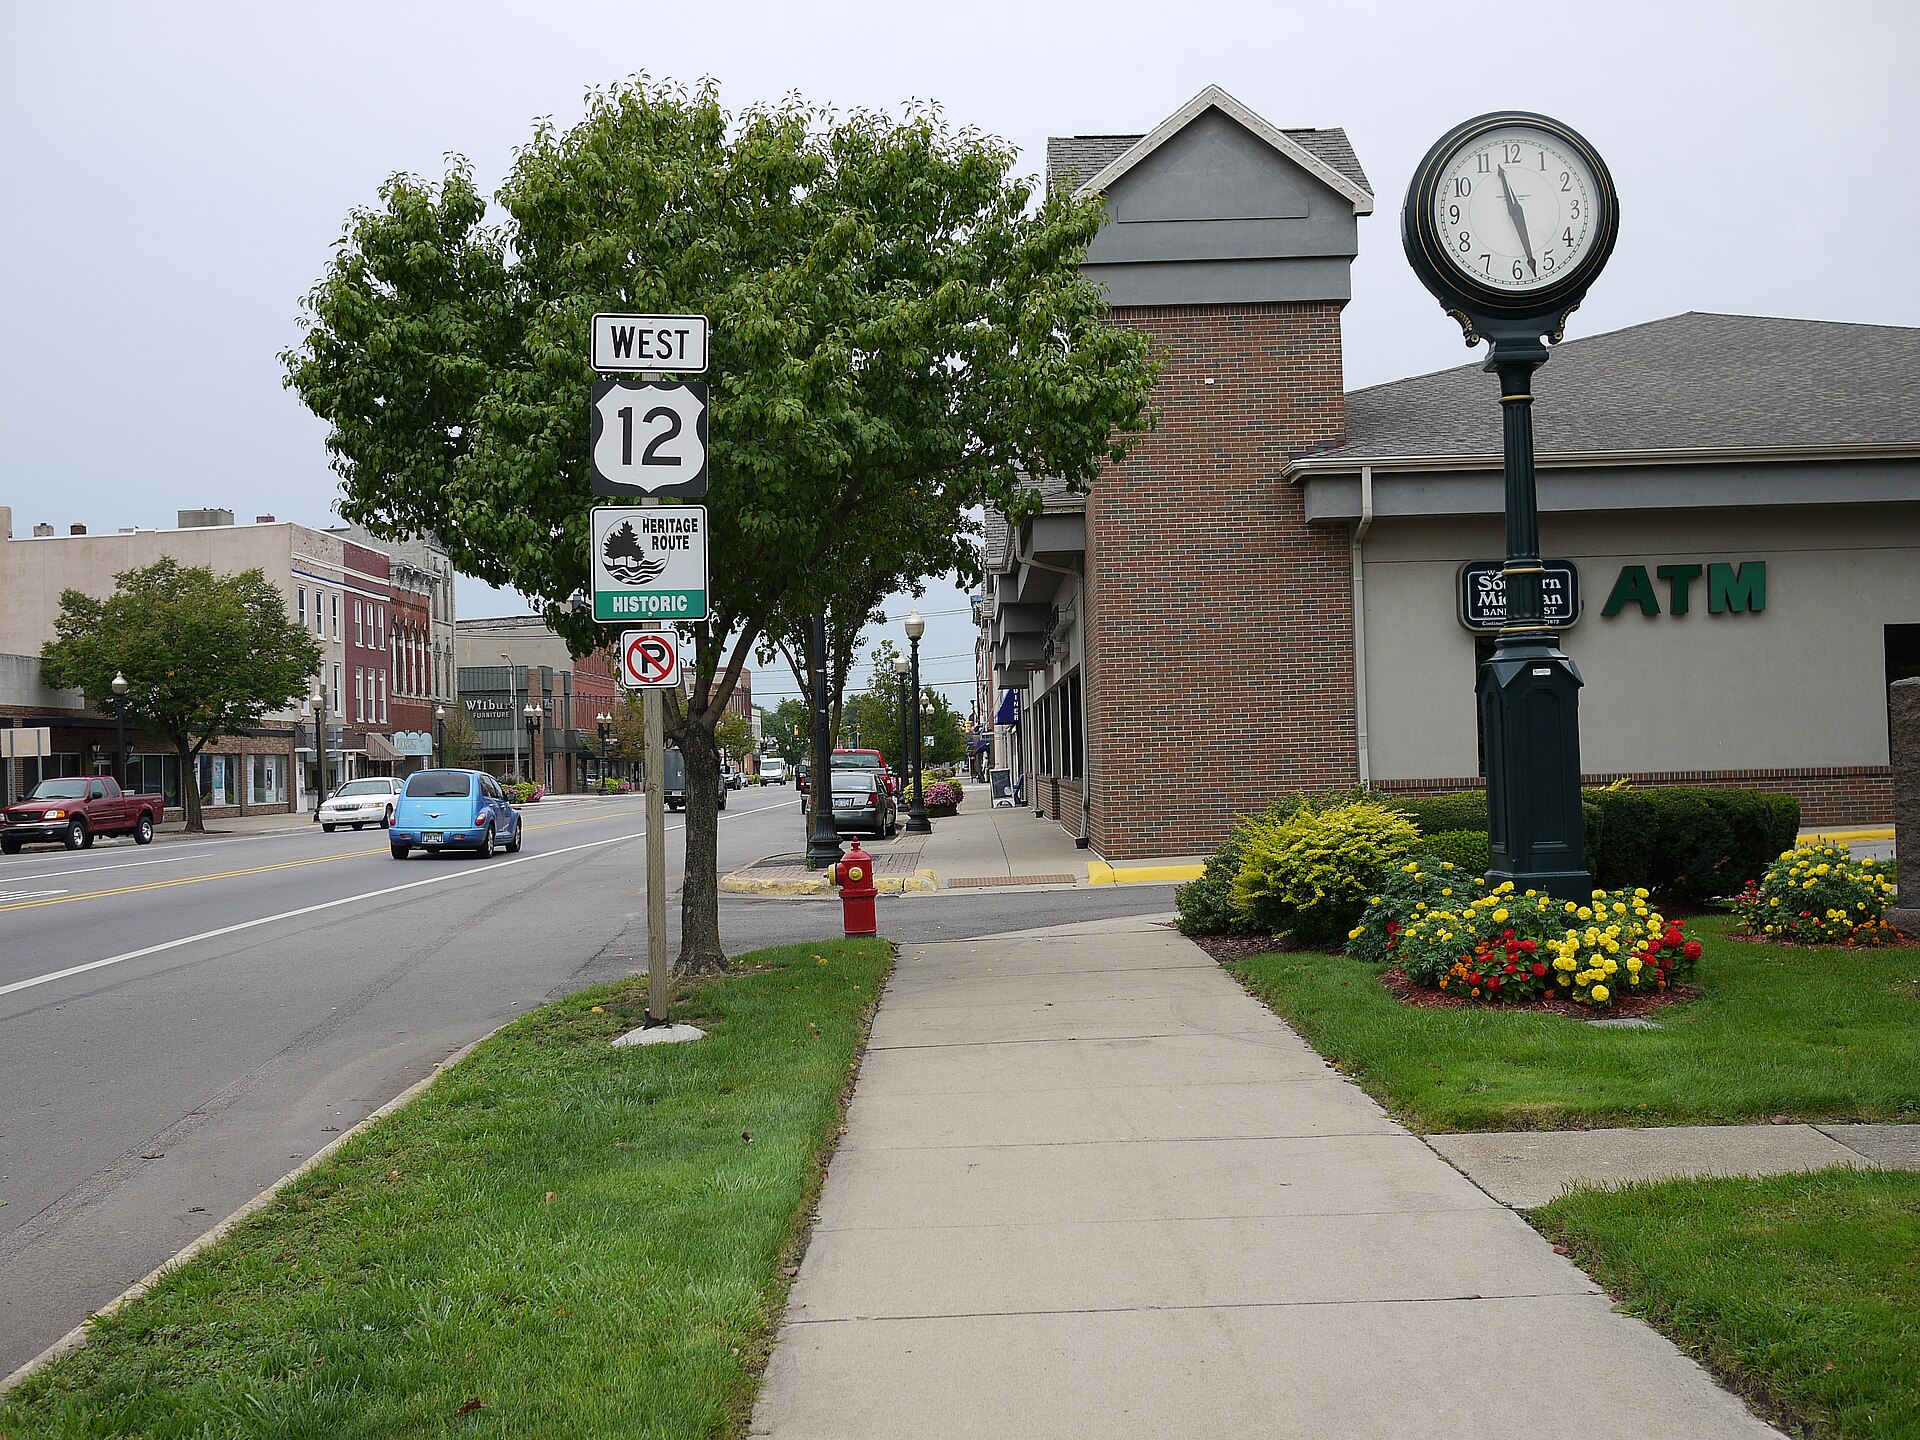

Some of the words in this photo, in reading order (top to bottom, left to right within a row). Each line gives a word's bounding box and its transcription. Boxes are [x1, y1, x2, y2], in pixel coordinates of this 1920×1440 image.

[1476, 153, 1491, 173] 11
[1502, 144, 1523, 164] 12
[1538, 151, 1547, 172] 1
[1453, 177, 1471, 197] 10
[1559, 171, 1573, 192] 2
[1449, 205, 1460, 225] 9
[1570, 199, 1580, 220] 3
[1459, 231, 1471, 252] 8
[1562, 226, 1574, 248] 4
[1478, 254, 1491, 275] 7
[1512, 260, 1523, 280] 6
[1543, 249, 1555, 271] 5
[610, 325, 690, 360] WEST
[617, 406, 682, 466] 12
[642, 518, 699, 534] HERITAGE
[651, 535, 690, 550] ROUTE
[1600, 560, 1767, 616] ATM
[613, 595, 688, 613] HISTORIC
[641, 643, 666, 674] P
[472, 711, 510, 719] FURNITURE
